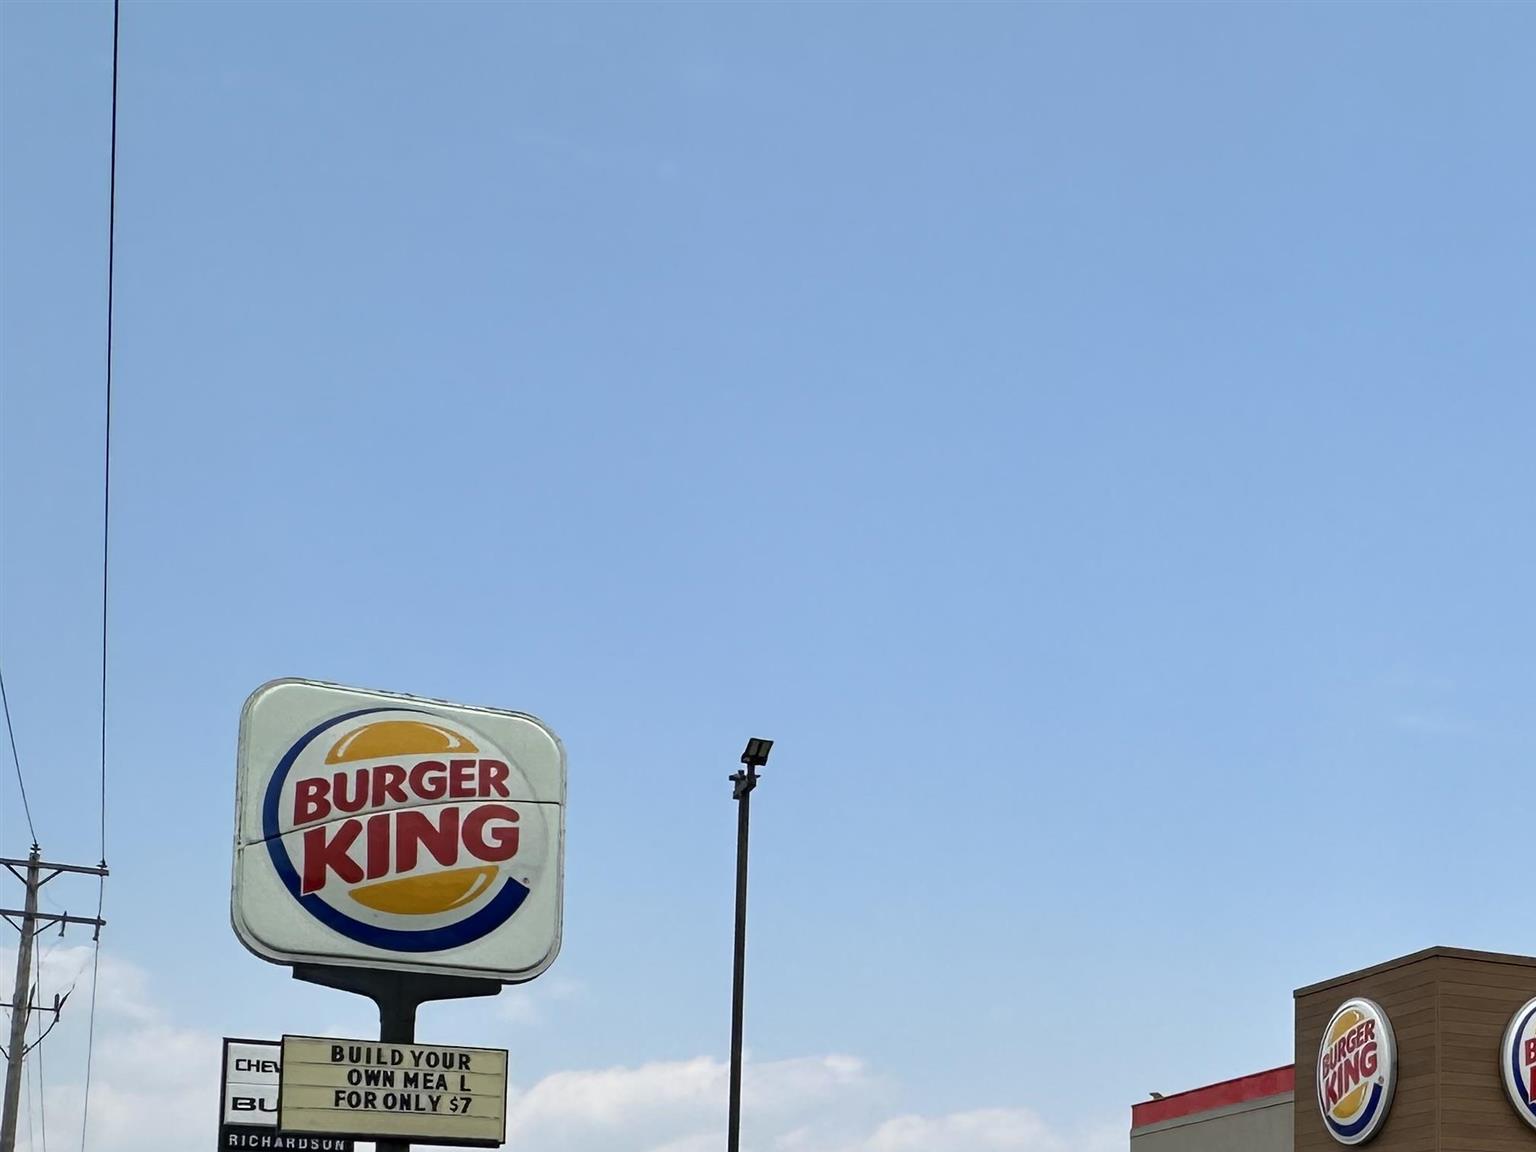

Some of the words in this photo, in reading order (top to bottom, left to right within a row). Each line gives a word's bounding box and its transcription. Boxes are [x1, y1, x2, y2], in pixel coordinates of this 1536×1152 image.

[293, 759, 511, 826] BURGER
[302, 804, 520, 894] KING
[331, 1045, 404, 1066] BUILD
[410, 1050, 472, 1071] YOUR
[1322, 1019, 1376, 1080] BURGER
[347, 1068, 395, 1088] OWN
[1325, 1041, 1378, 1114] KING
[334, 1090, 377, 1109] FOR
[382, 1093, 442, 1112] ONLY
[449, 1096, 473, 1114] $7
[228, 1134, 346, 1151] RICHARDSON
